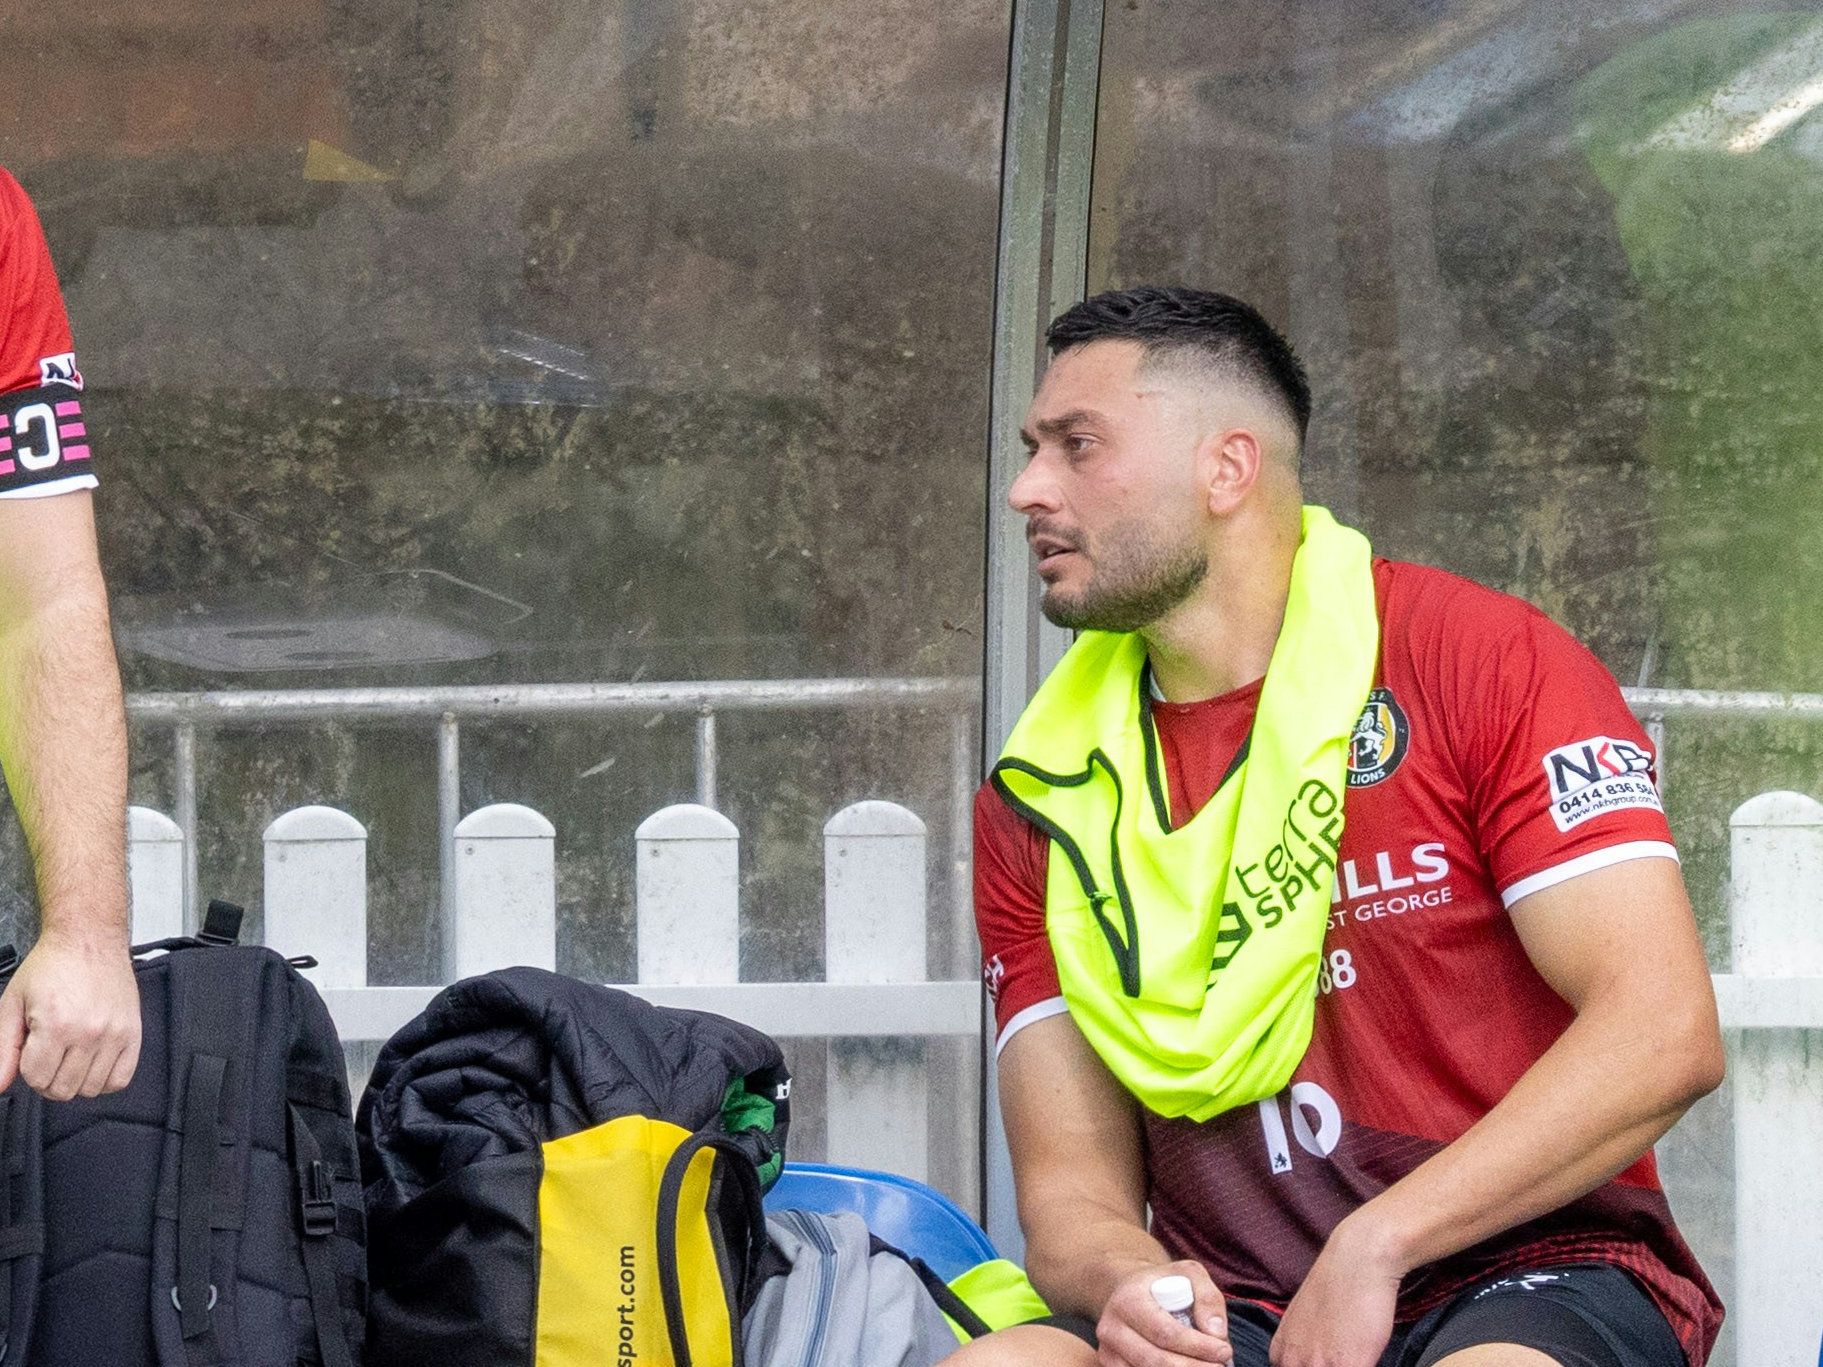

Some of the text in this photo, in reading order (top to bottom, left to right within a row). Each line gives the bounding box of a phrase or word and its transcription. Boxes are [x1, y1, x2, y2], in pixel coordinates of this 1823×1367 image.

[1350, 767, 1386, 785] LIONS
[1559, 788, 1603, 814] 0414
[1605, 782, 1634, 795] 836
[1235, 779, 1338, 899] terra
[1354, 886, 1454, 923] GEORGE
